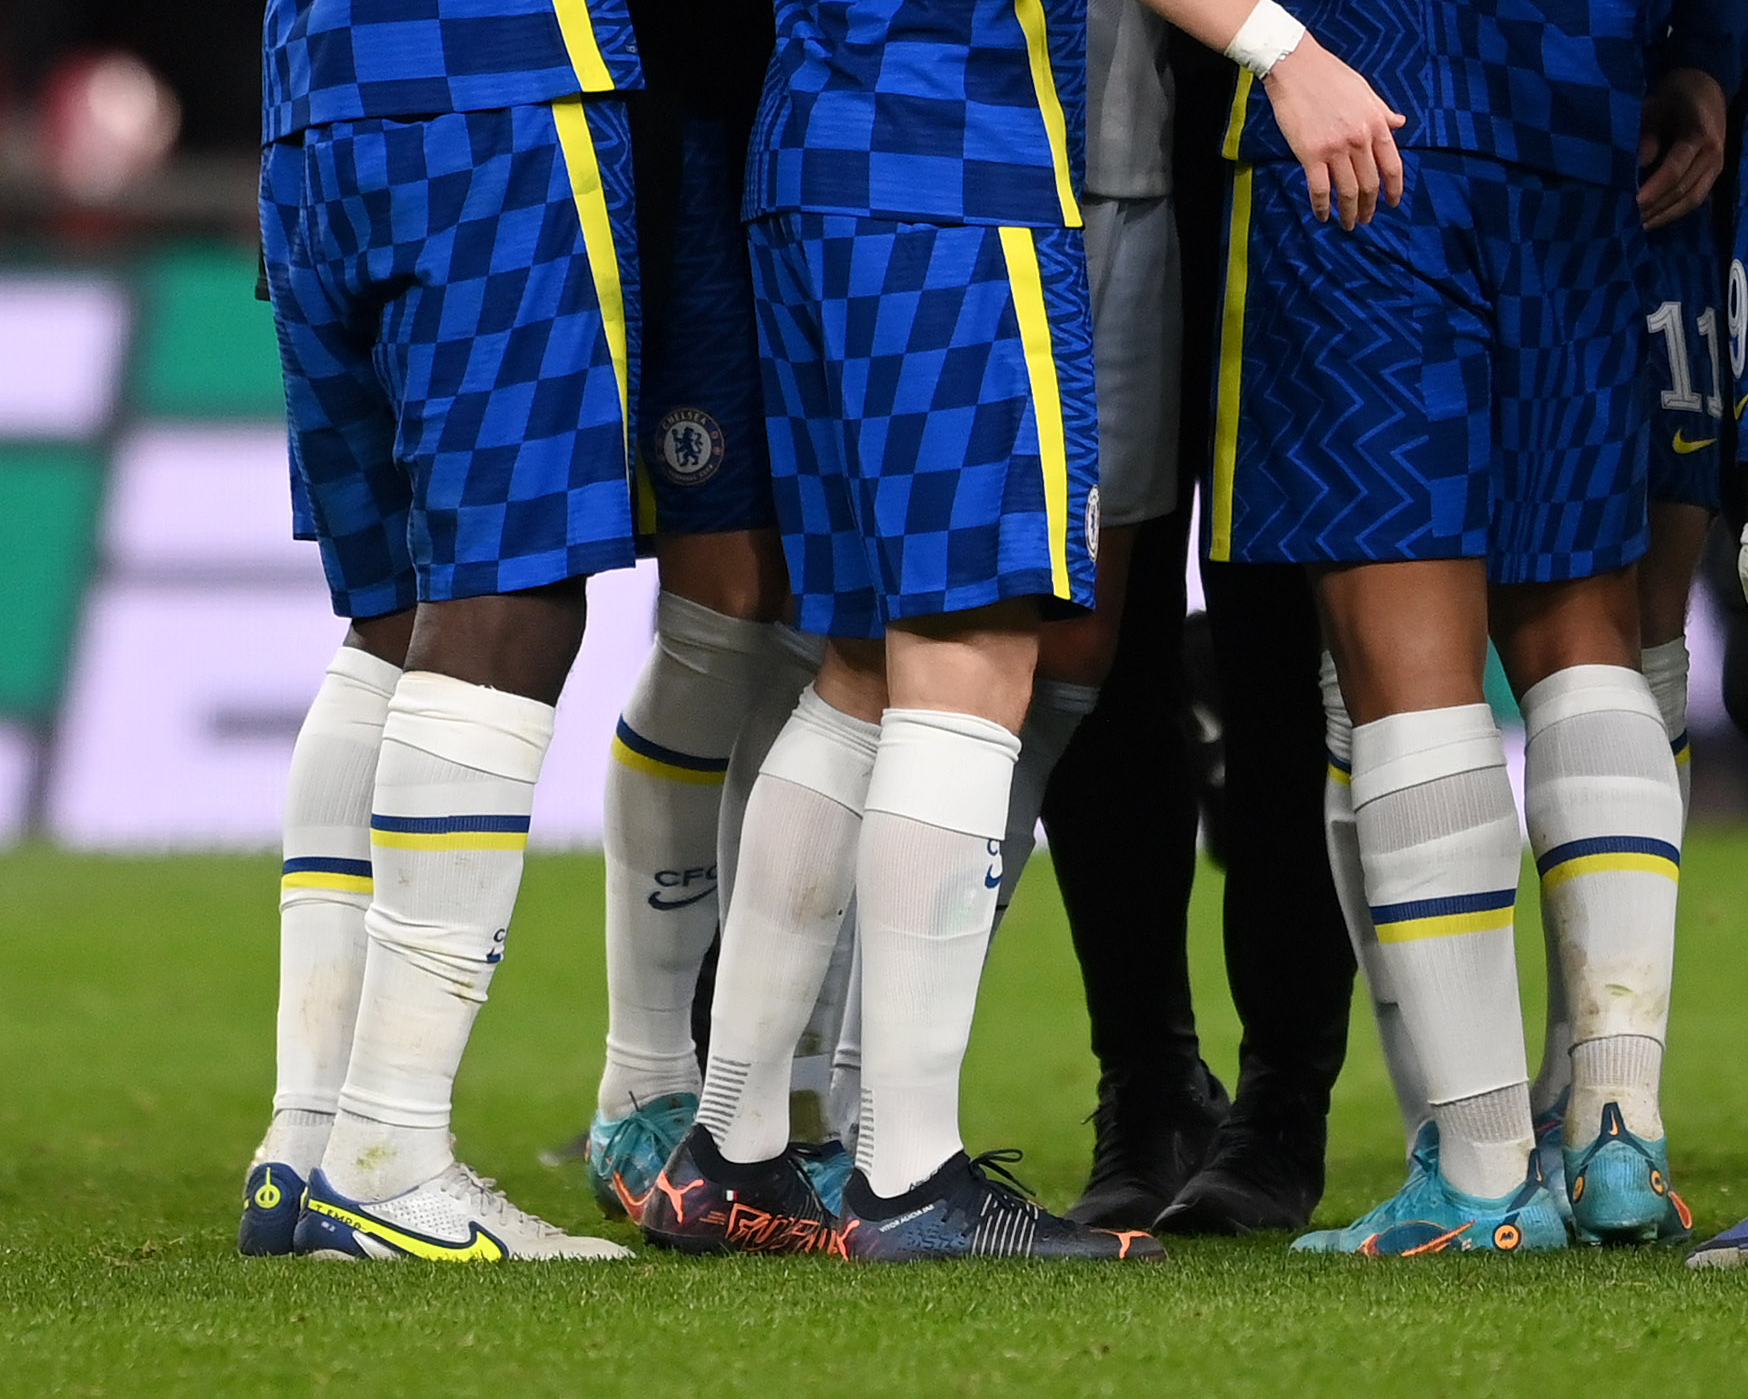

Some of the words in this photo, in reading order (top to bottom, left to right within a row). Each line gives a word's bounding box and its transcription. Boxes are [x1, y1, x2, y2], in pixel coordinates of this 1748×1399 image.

[1728, 259, 1748, 379] 9
[1646, 301, 1723, 418] 11
[662, 411, 706, 430] CHELSEA
[879, 1219, 900, 1233] VITOR
